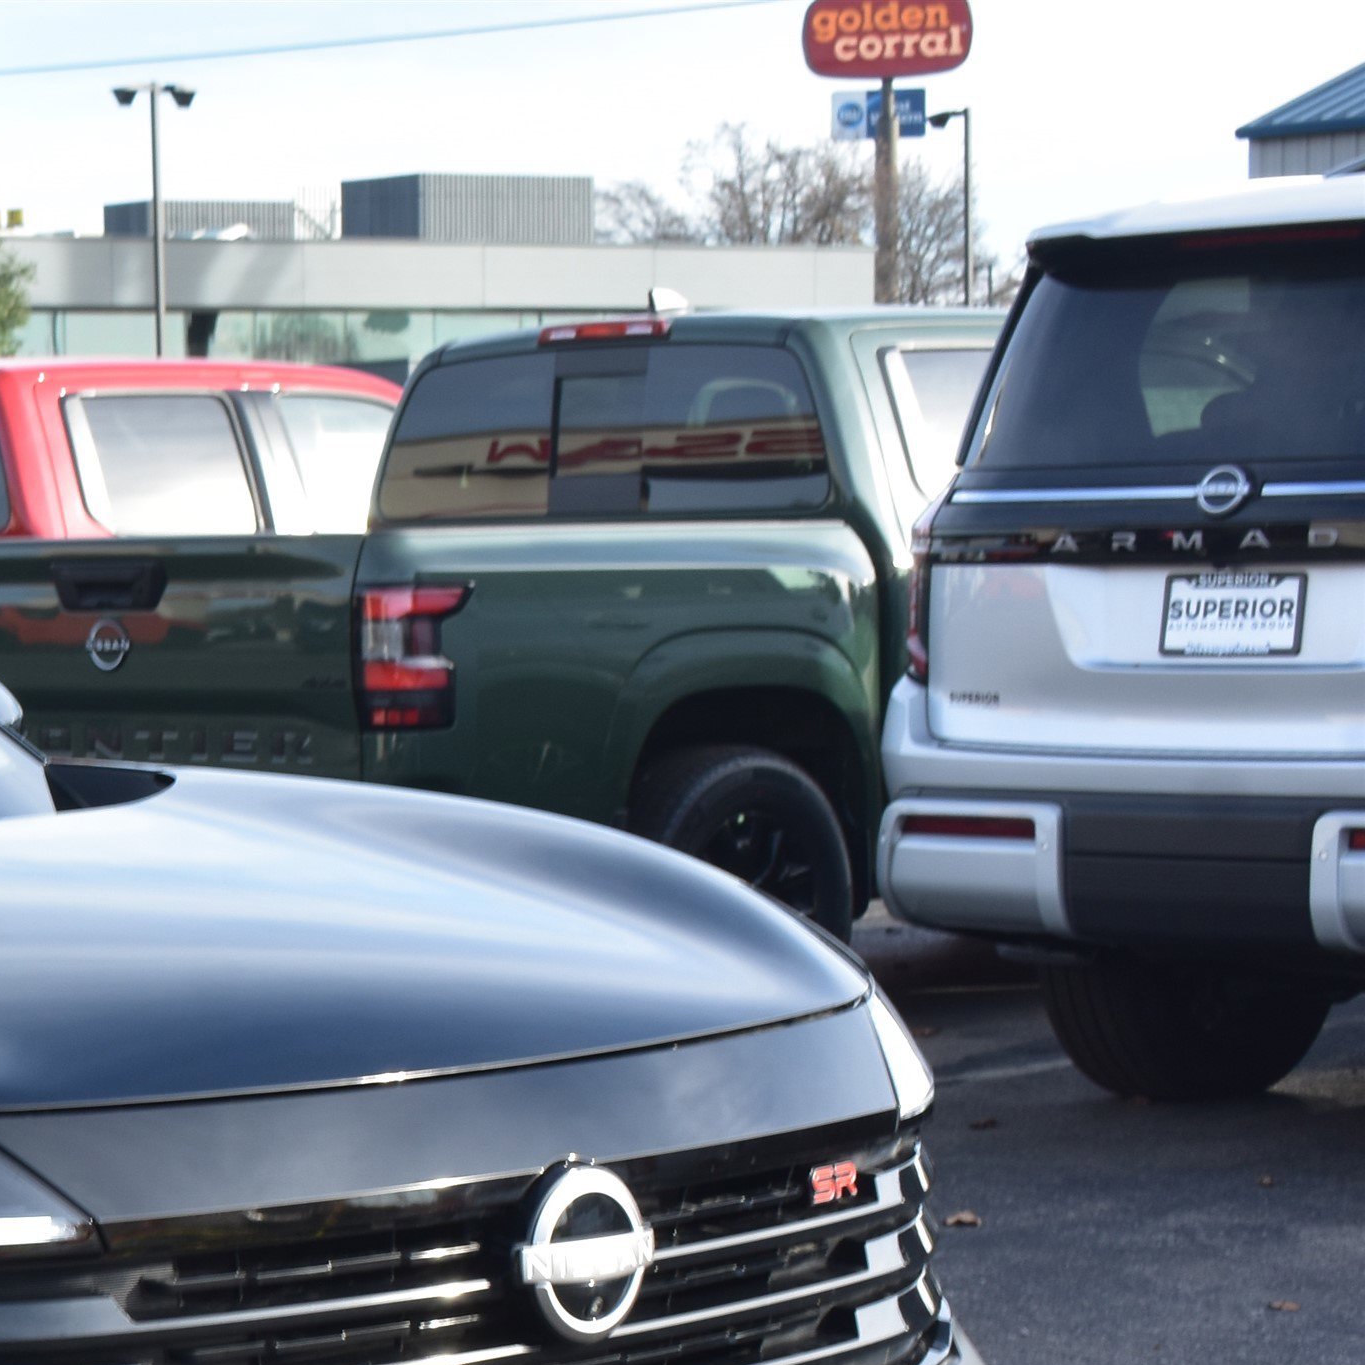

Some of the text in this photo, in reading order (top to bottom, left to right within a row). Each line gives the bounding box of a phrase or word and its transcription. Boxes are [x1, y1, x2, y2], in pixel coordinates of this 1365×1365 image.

[812, 2, 950, 43] golden
[834, 25, 963, 61] corral
[1169, 599, 1295, 619] SUPERIOR
[949, 690, 1001, 705] SUPERIOR
[812, 1160, 858, 1205] SR
